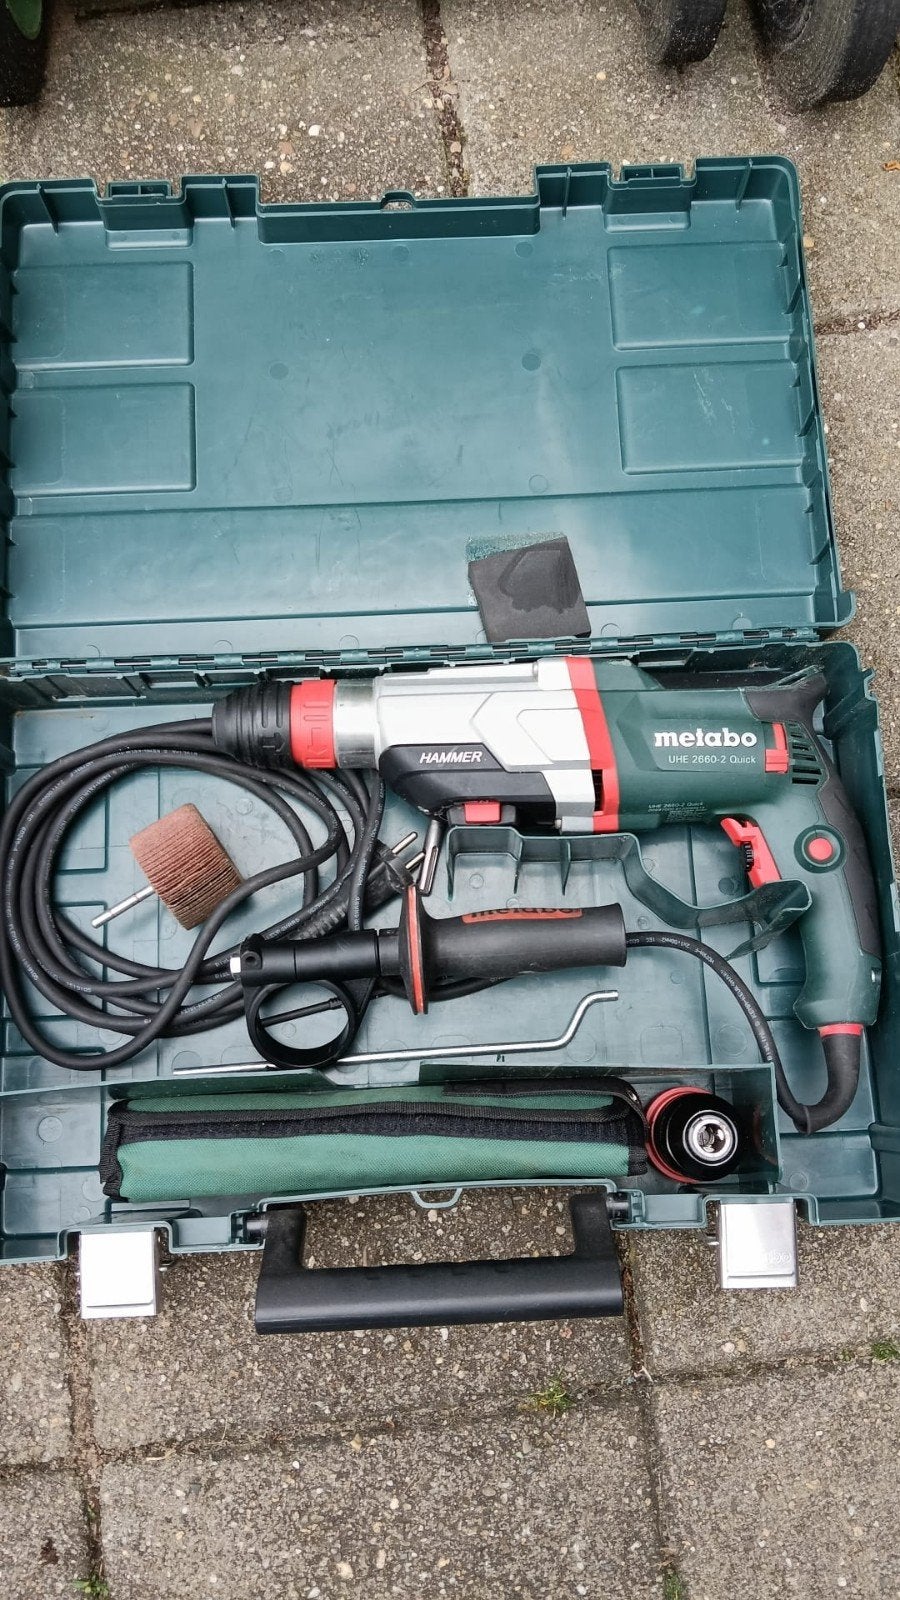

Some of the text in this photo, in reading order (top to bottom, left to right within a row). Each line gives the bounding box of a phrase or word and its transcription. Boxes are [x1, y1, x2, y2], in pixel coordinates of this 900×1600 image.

[654, 727, 758, 748] metabo
[419, 751, 483, 764] HAMMER
[668, 754, 756, 764] UHE 2660-2 Quick
